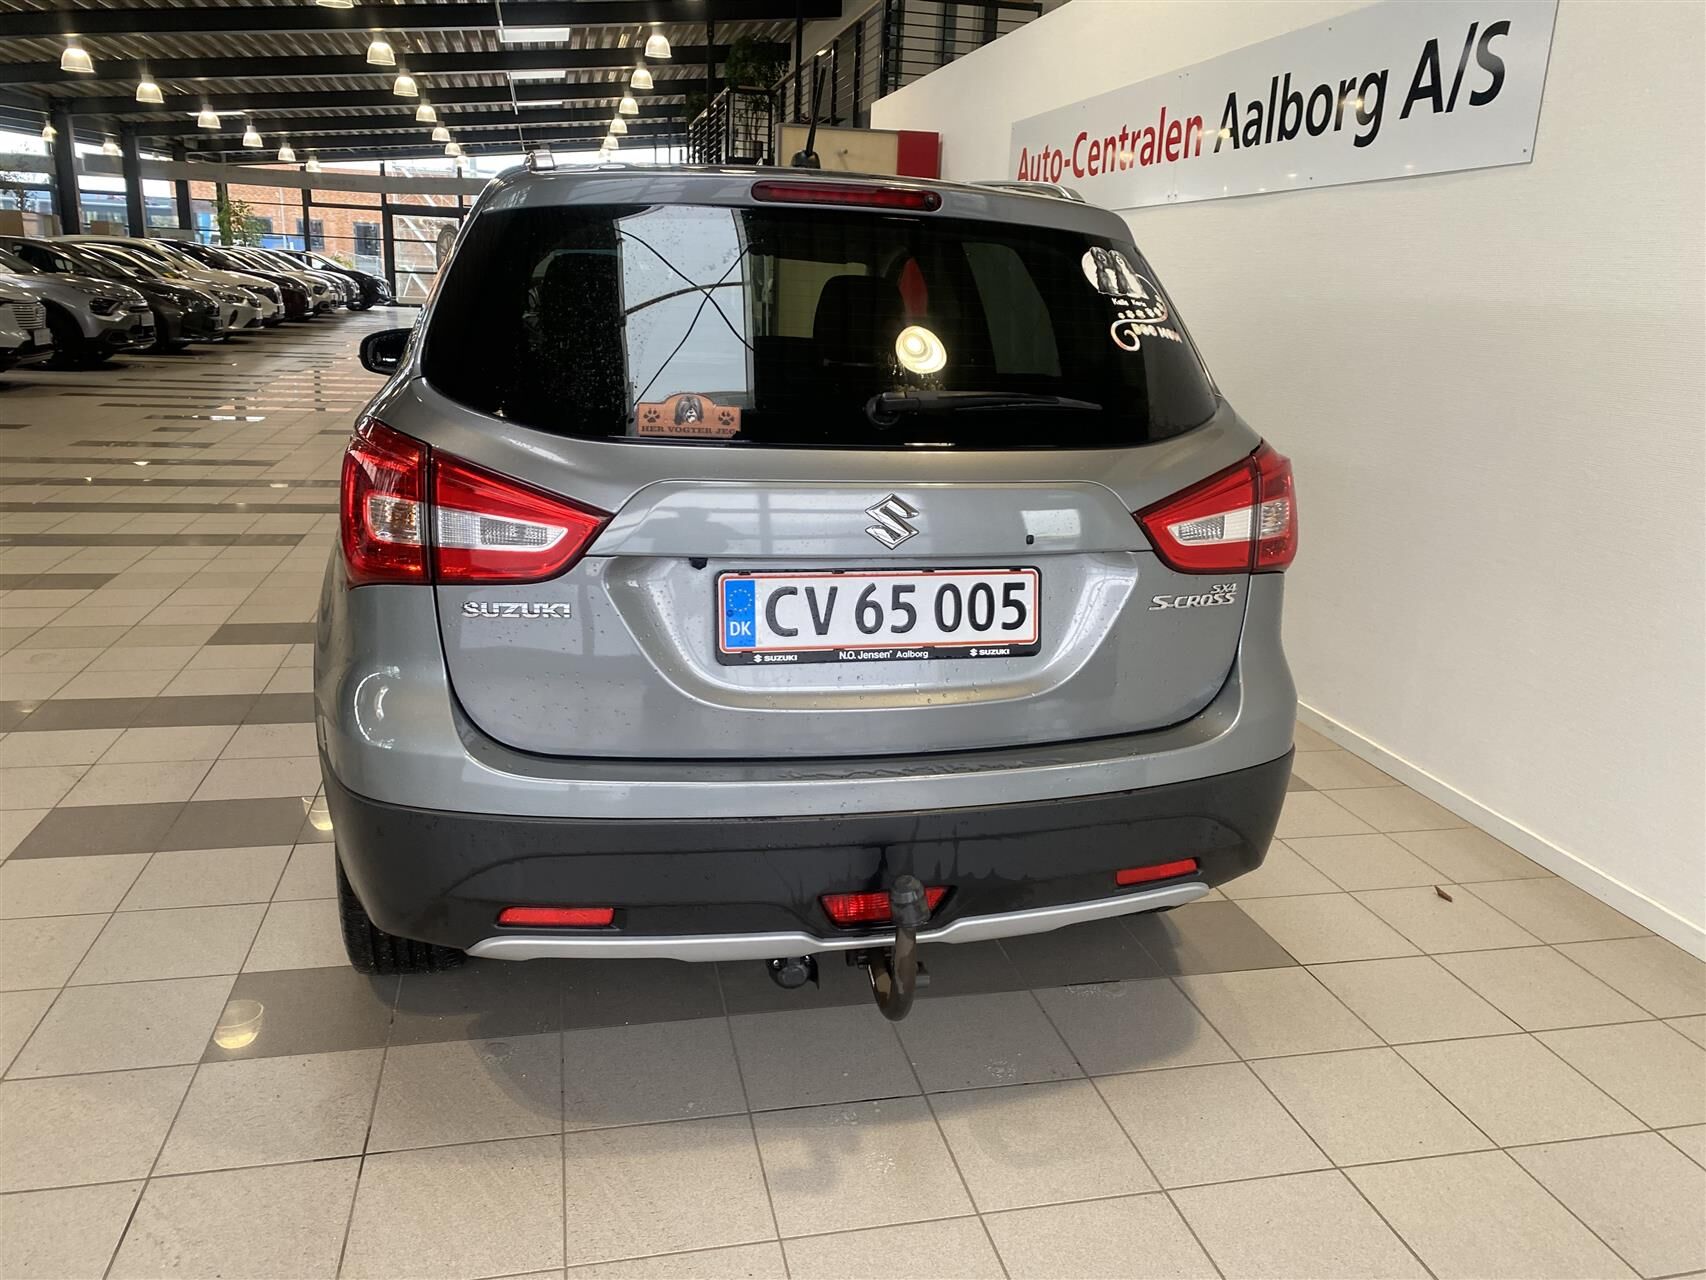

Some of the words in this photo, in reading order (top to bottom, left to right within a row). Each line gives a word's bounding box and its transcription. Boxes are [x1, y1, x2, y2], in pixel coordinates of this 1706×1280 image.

[1017, 107, 1203, 182] Auto-Centralen
[1213, 69, 1388, 153] Aalborg
[1399, 20, 1511, 119] A/S
[641, 425, 665, 433] HER
[668, 426, 712, 434] VOGTER
[1210, 583, 1237, 593] SX4
[1148, 592, 1237, 611] S-CROSS
[461, 601, 571, 619] SUZUKI
[765, 585, 838, 637] CV
[854, 582, 917, 634] 65
[934, 582, 1027, 633] 005
[729, 621, 751, 635] DK
[896, 650, 929, 658] Aalborg
[978, 648, 1010, 656] SUZUKI
